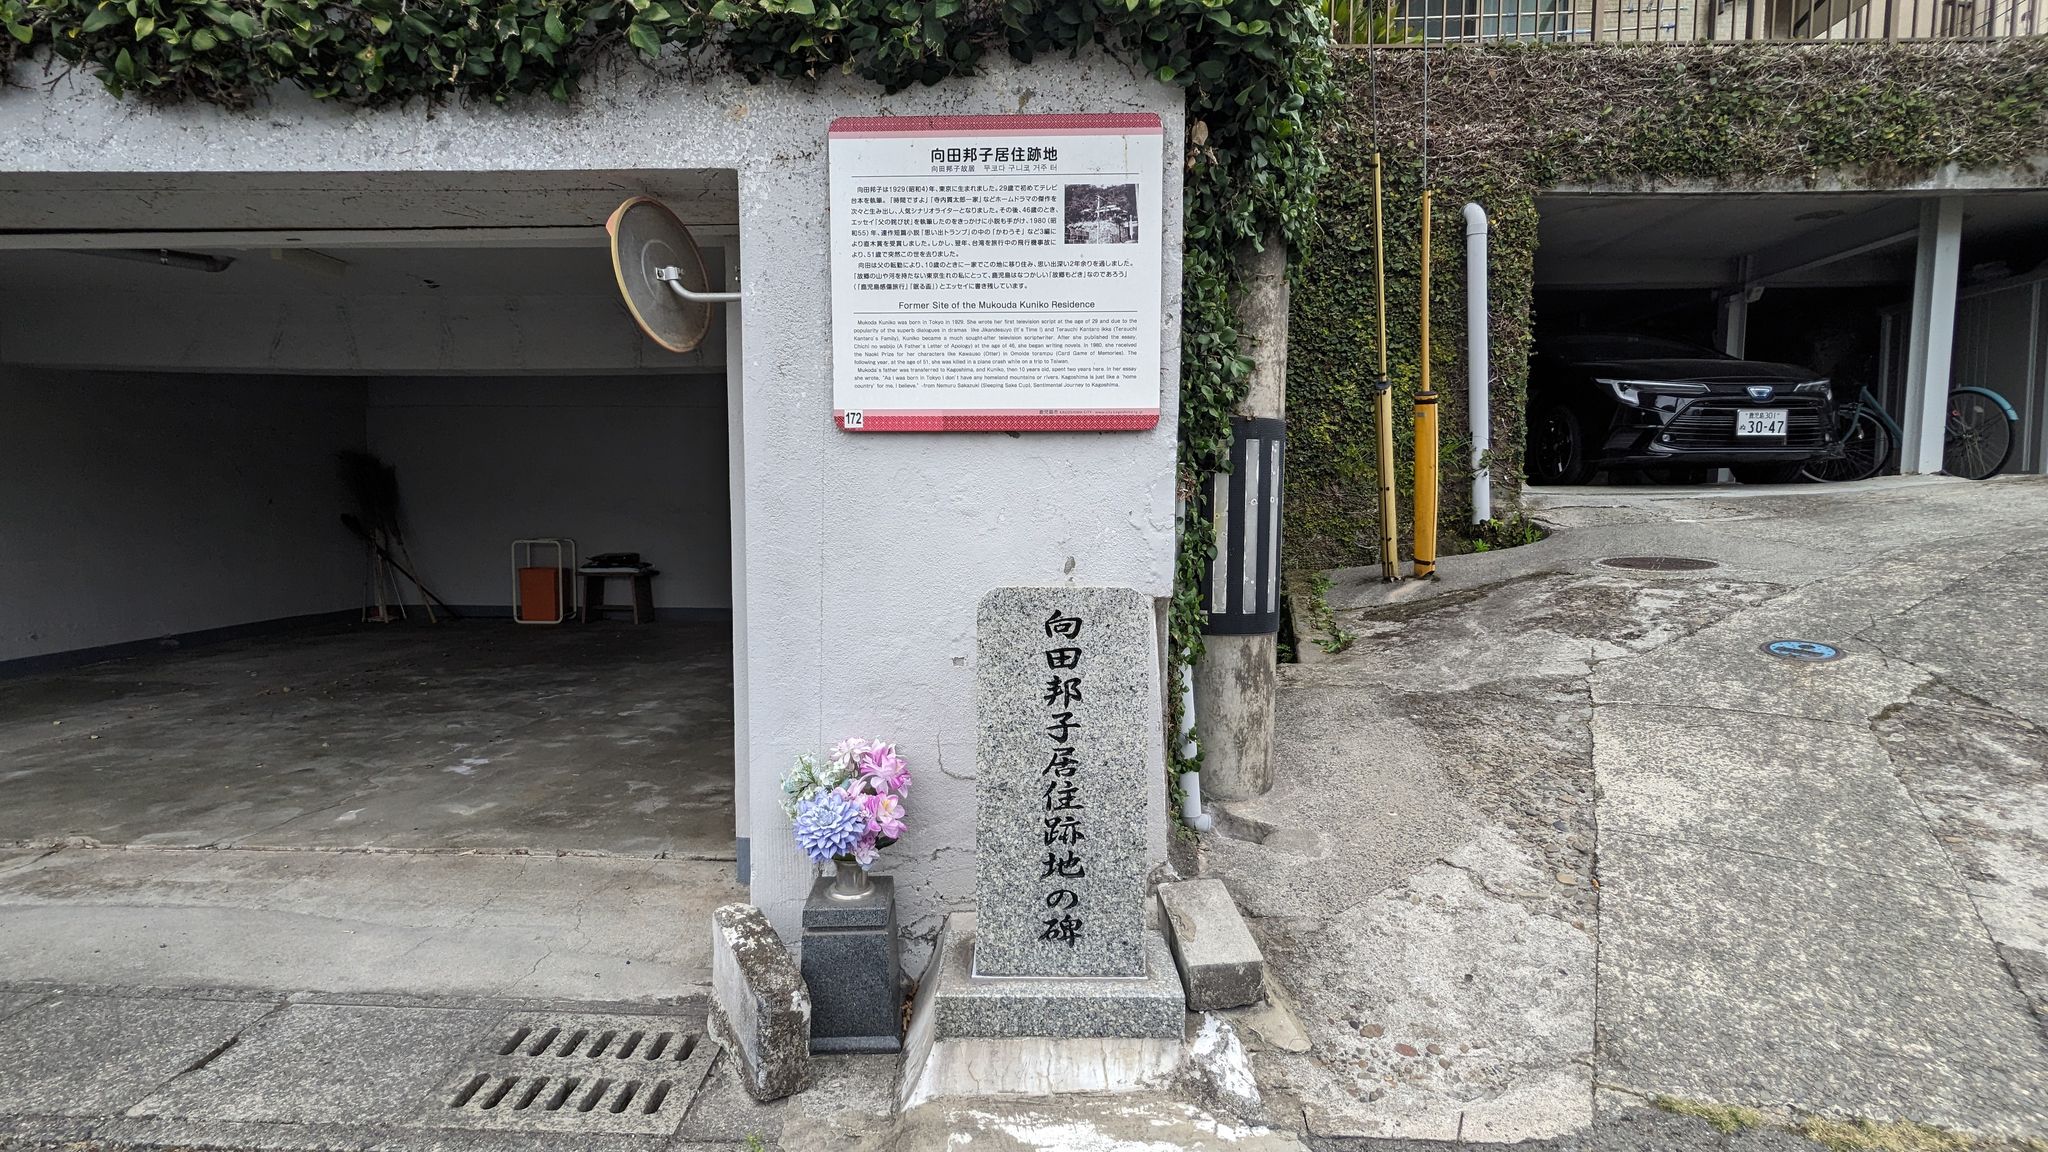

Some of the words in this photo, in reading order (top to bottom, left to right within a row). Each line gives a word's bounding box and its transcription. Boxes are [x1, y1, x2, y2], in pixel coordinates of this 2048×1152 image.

[931, 146, 1058, 162] 向田邦子居住跡地
[846, 412, 862, 424] 172
[1747, 421, 1784, 433] 30-47
[1038, 609, 1085, 947] 向田邦子居住跡地の碑
